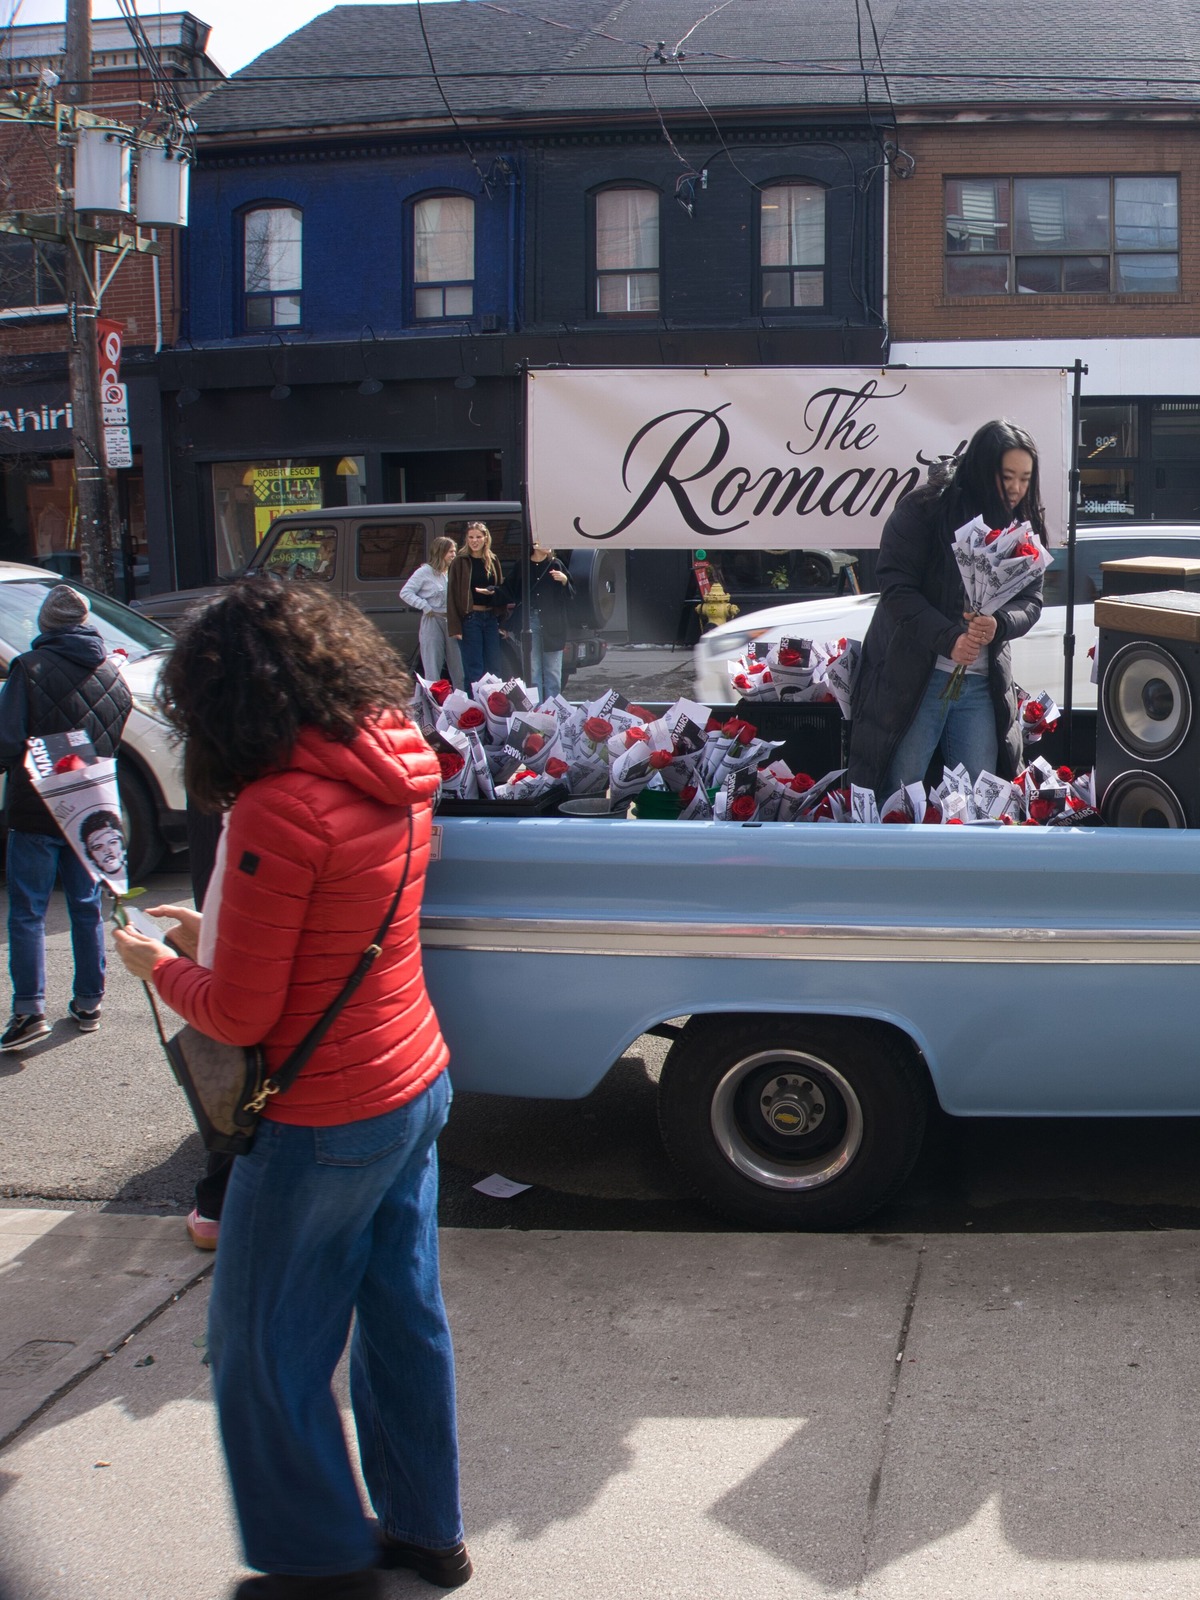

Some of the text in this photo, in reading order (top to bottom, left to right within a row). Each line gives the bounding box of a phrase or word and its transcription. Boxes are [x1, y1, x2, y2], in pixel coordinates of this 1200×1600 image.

[786, 379, 907, 455] The
[1095, 436, 1117, 447] 803
[257, 467, 315, 477] ROBERT ESCOE
[270, 479, 317, 493] CITY
[603, 691, 620, 715] MARS
[676, 714, 689, 734] MARS
